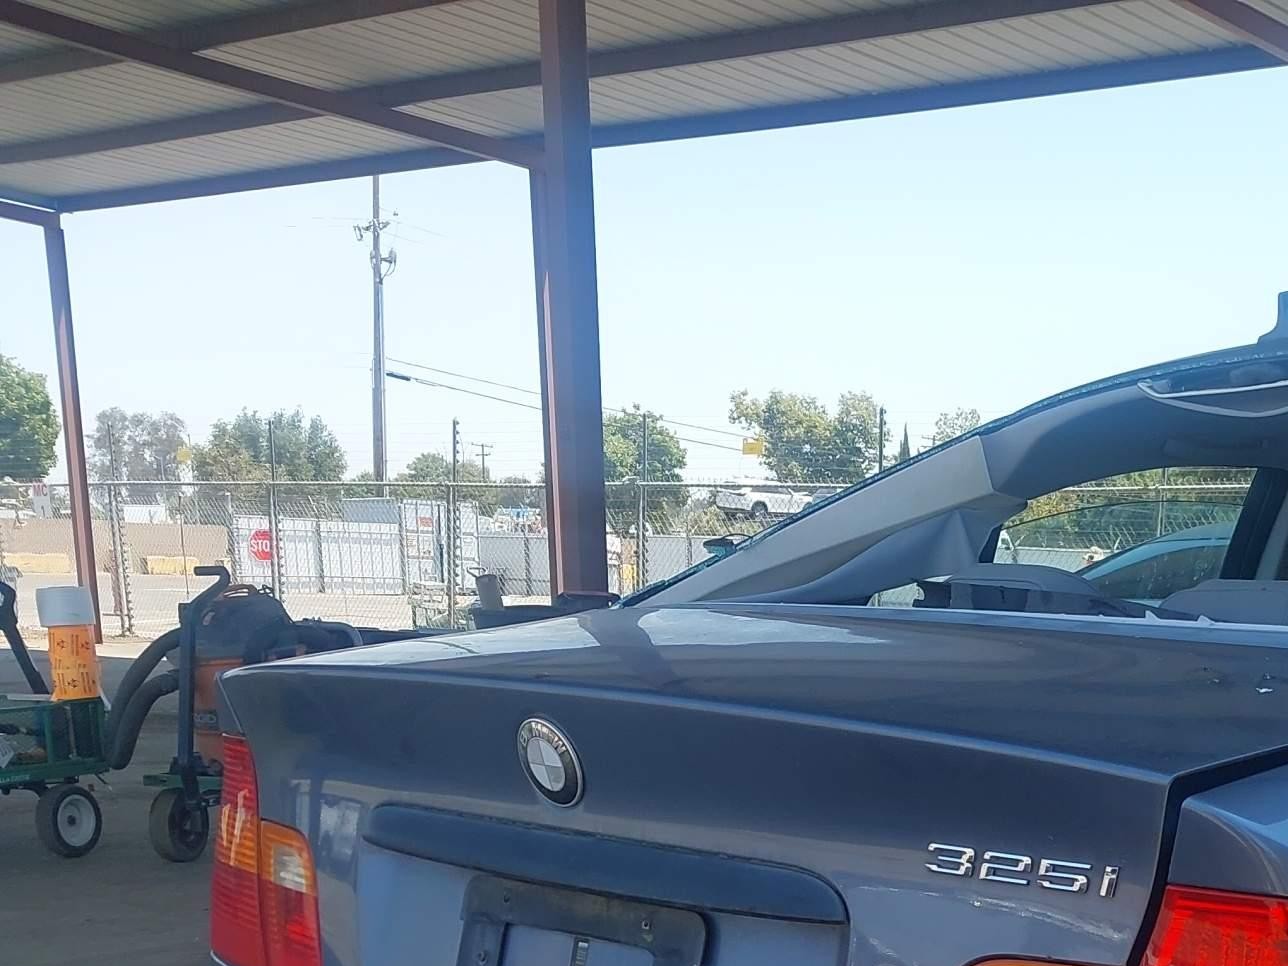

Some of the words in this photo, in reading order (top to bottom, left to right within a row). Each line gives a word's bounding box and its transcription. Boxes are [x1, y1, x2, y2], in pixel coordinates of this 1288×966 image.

[250, 540, 271, 553] STO
[518, 721, 568, 755] BMW
[924, 842, 1120, 898] 325i
